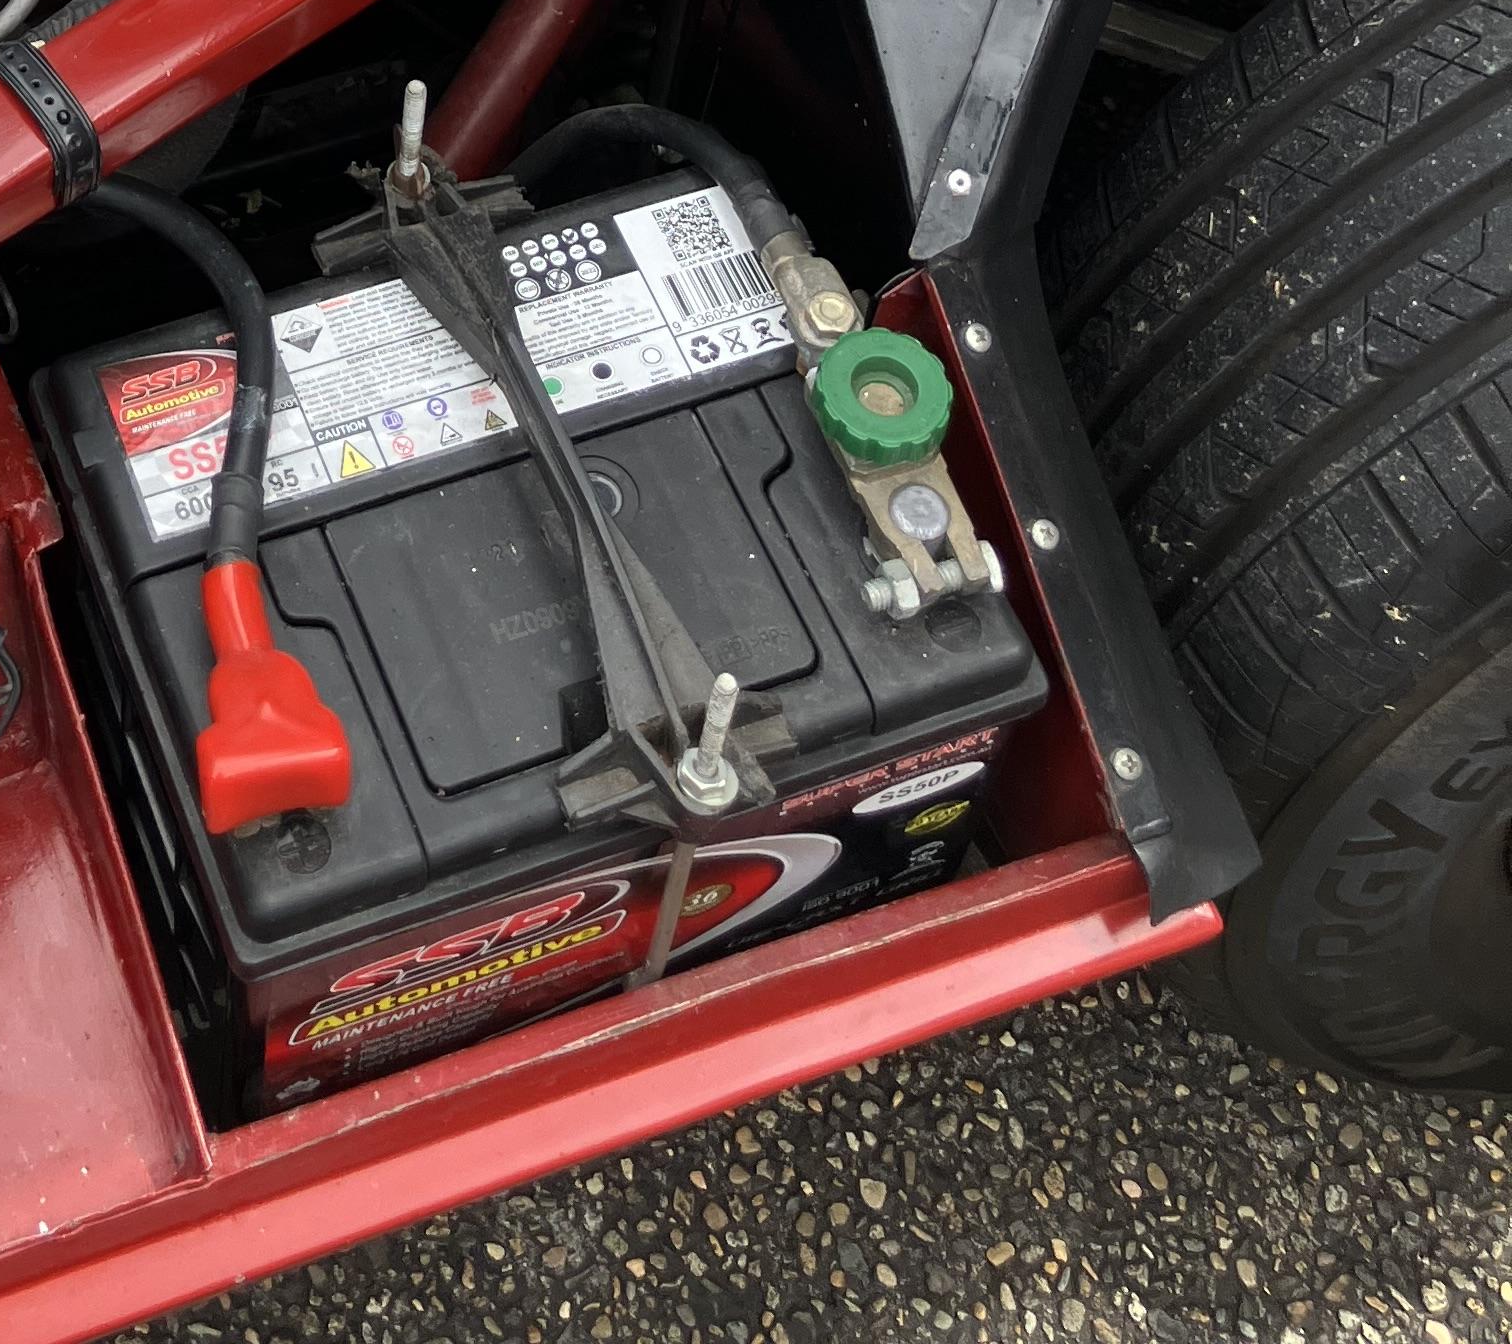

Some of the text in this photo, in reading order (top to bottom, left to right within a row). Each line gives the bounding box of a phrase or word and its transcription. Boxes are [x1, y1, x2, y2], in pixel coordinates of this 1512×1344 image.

[518, 293, 572, 314] REPLACEMENT
[574, 280, 614, 298] WARRANTY
[671, 320, 683, 334] 9
[688, 304, 738, 328] 336054
[346, 334, 435, 365] SERVICE REQUIREMENTS
[545, 336, 642, 371] INDICATOR INSTRUCTIONS
[121, 359, 202, 405] SSB
[125, 383, 220, 421] Automotive
[131, 413, 178, 434] MAINTENANCE
[314, 419, 368, 442] CAUTION
[180, 458, 283, 496] CCA RC
[267, 467, 300, 491] 95
[895, 726, 1000, 772] START
[878, 769, 960, 804] SS50P
[318, 890, 587, 1004] SSB
[305, 923, 603, 1038] Automotive
[312, 994, 457, 1050] MAINTENANCE
[461, 971, 514, 999] FREE
